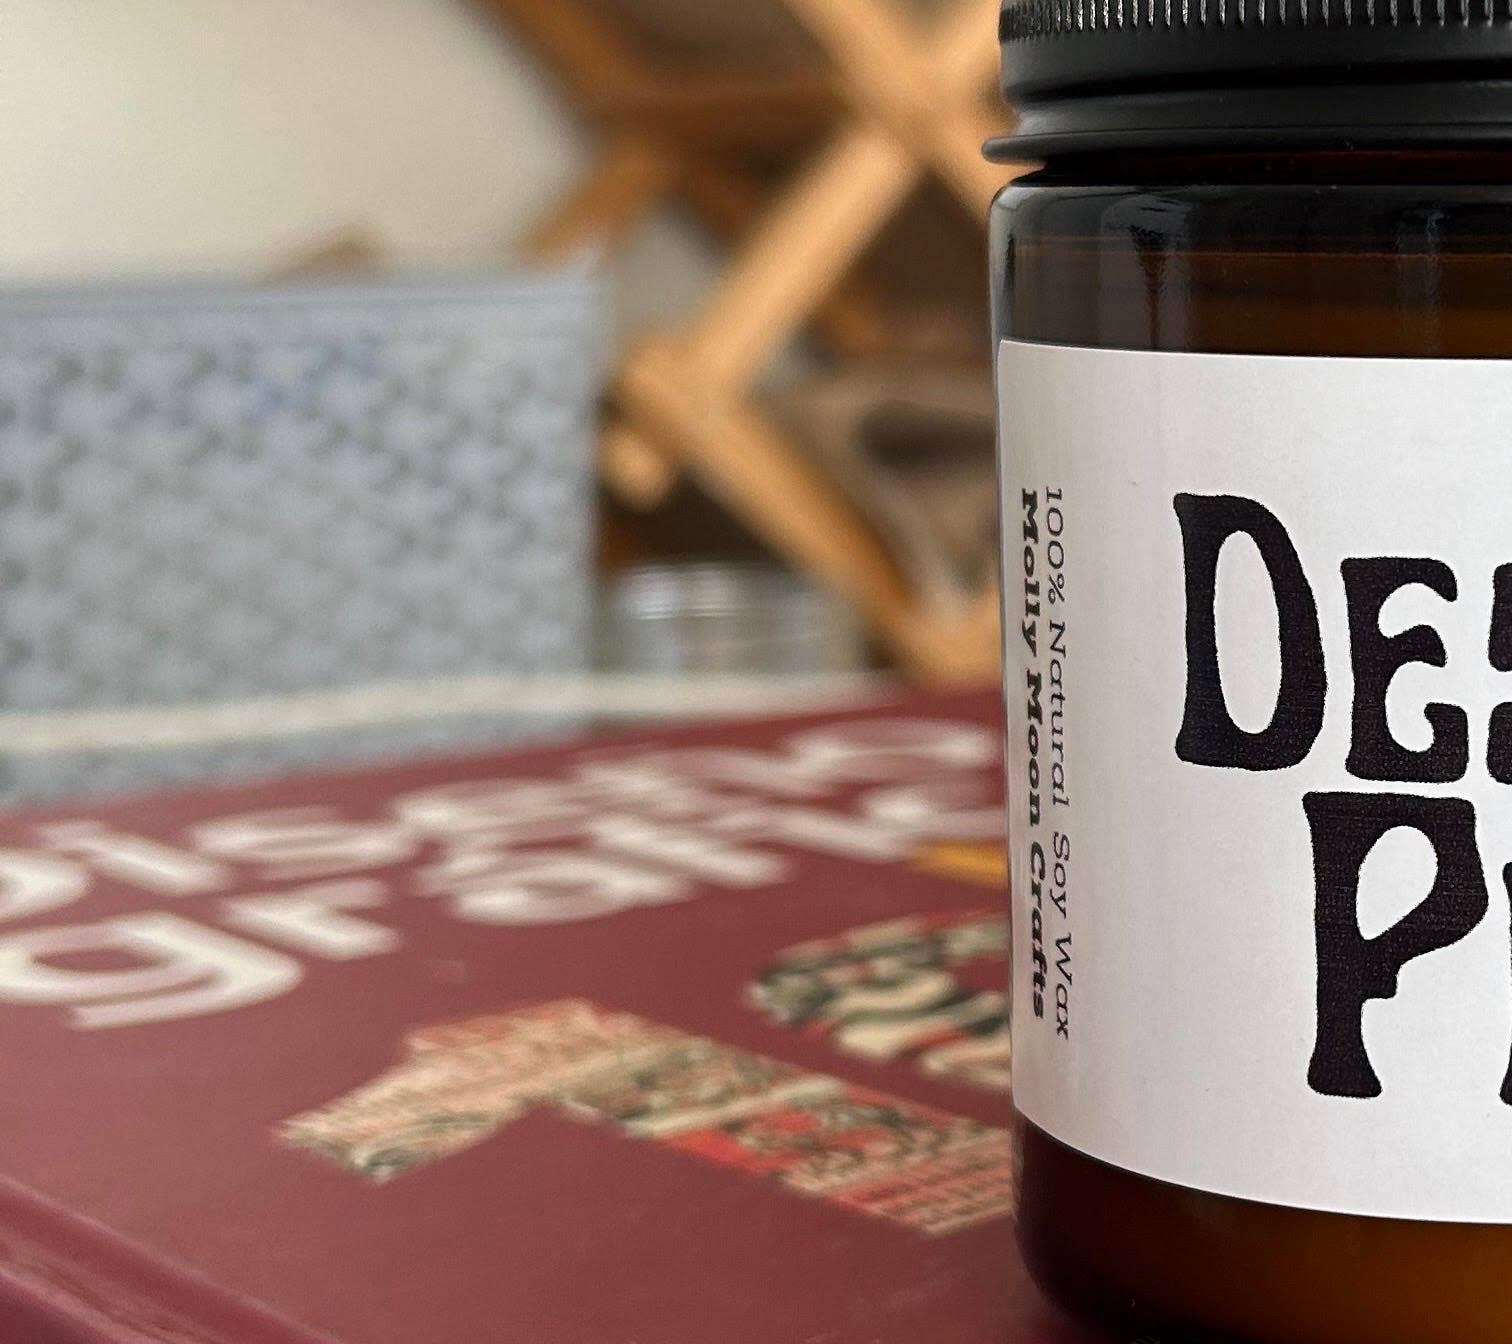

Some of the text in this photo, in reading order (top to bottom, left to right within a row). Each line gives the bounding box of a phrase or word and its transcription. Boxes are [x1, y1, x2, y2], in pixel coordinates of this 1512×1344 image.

[1022, 487, 1048, 1020] Molly Moon Crafts
[1046, 486, 1073, 1041] 100% Natural Soy Wax
